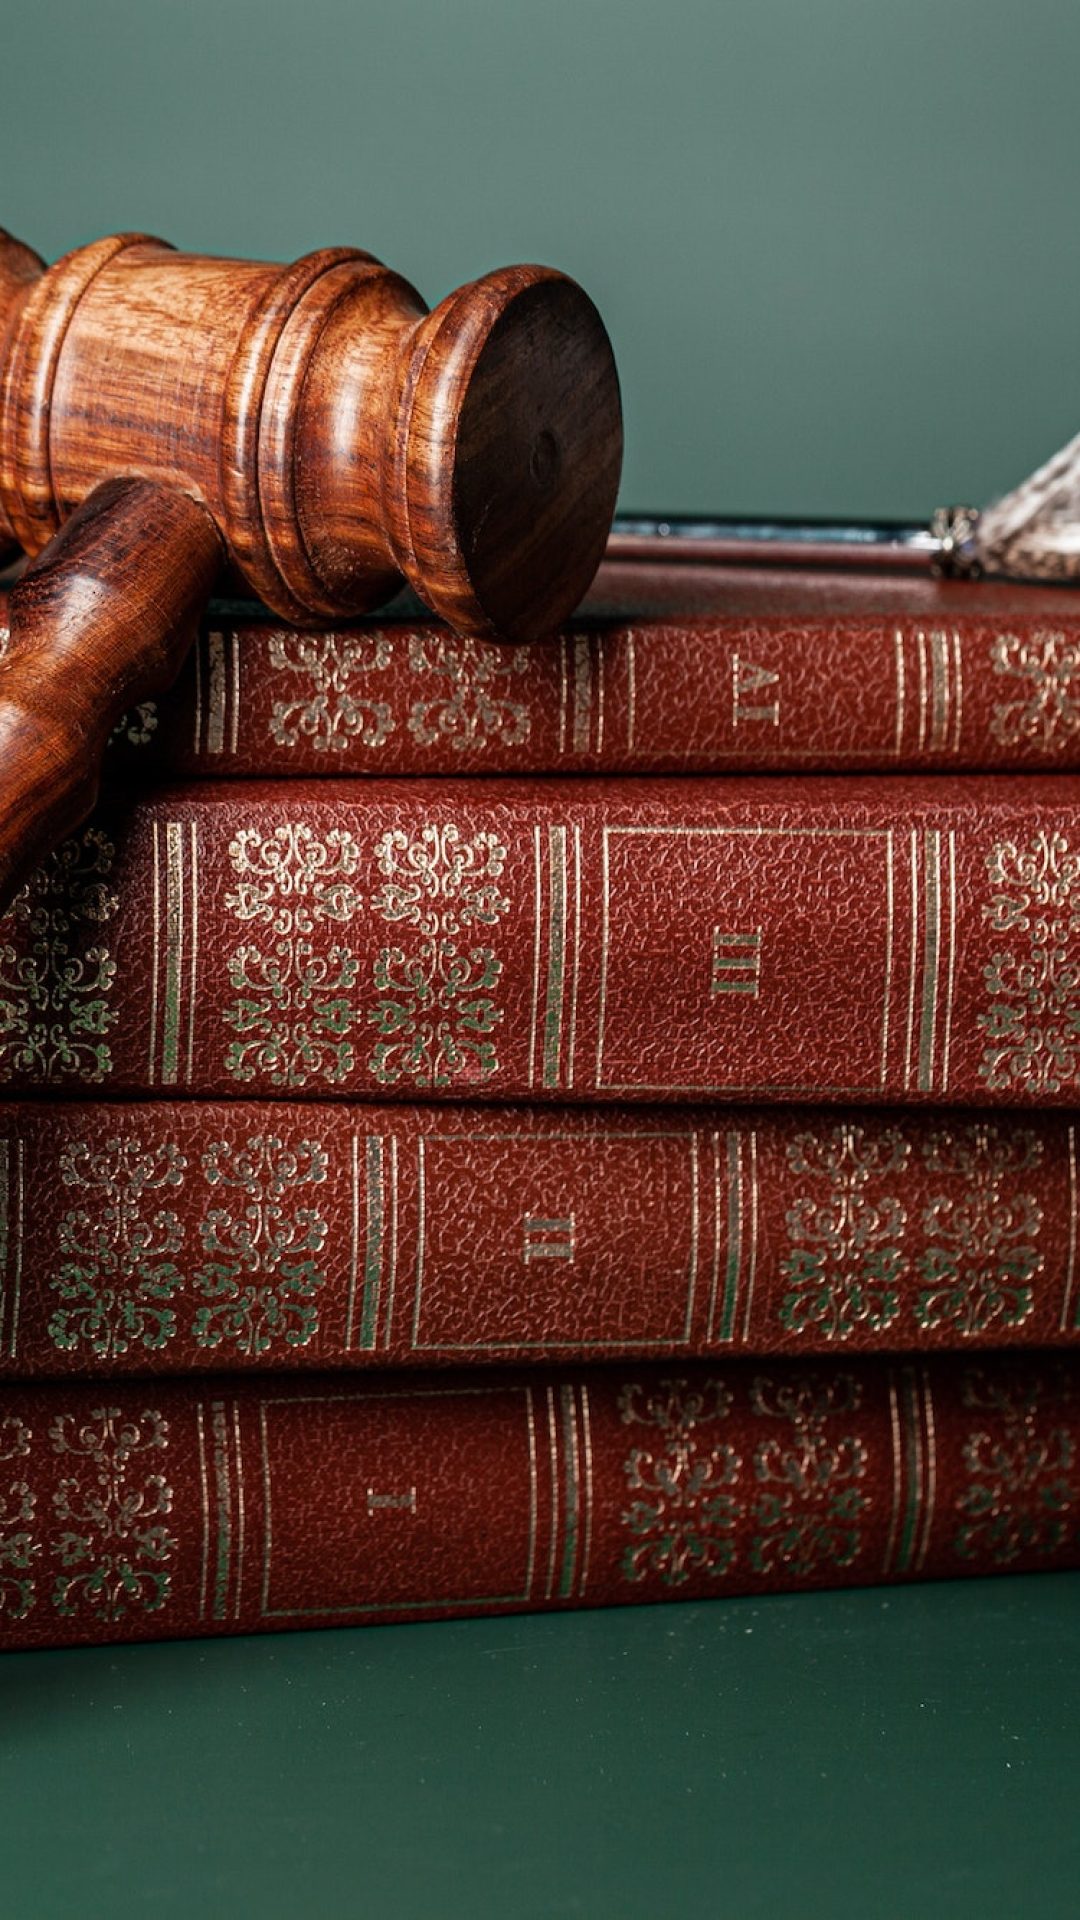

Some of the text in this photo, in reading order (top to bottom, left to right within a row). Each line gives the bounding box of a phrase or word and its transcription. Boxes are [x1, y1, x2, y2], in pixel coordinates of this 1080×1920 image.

[732, 653, 779, 726] IV
[711, 925, 762, 999] III
[523, 1211, 575, 1265] II
[367, 1486, 417, 1516] I
